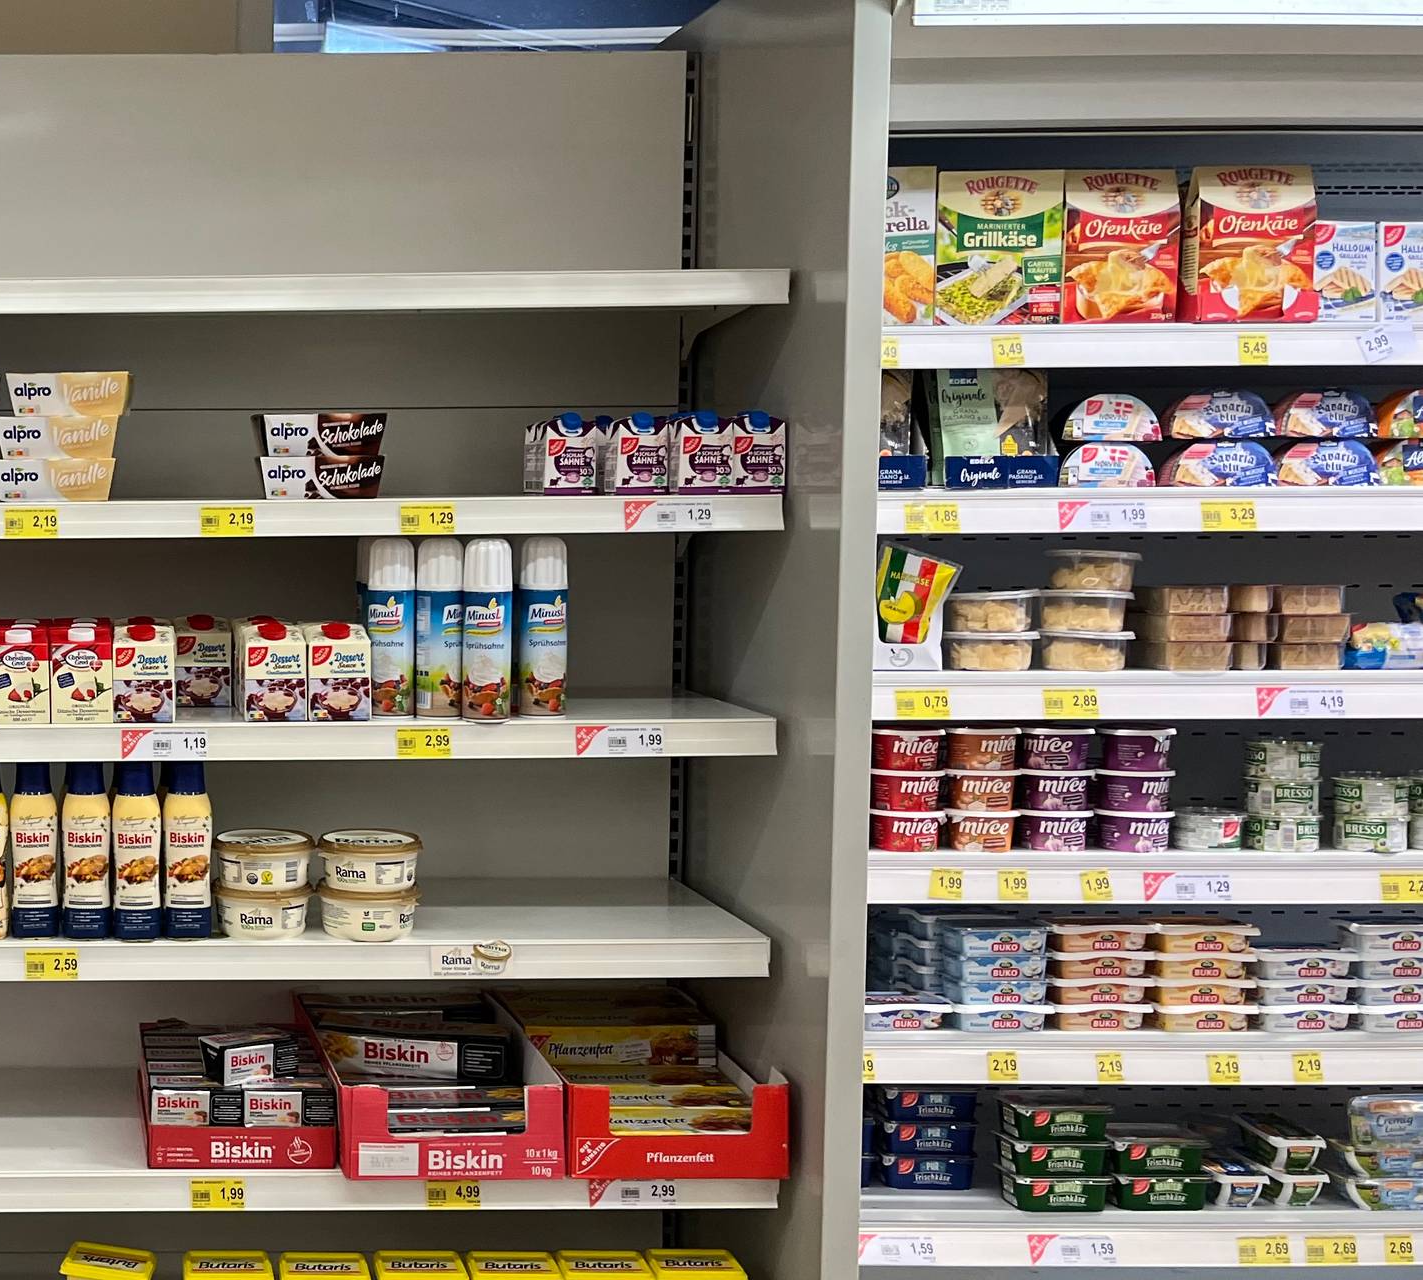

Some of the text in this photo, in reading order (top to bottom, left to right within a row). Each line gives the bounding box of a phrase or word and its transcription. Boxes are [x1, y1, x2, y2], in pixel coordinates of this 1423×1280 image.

[1217, 167, 1296, 187] ROUGETTE
[965, 175, 1041, 195] ROUGETTE
[977, 223, 1026, 231] MARINIERTER
[1086, 218, 1162, 238] Ofenkäse
[1219, 215, 1298, 235] Ofenkäse
[964, 232, 1037, 248] Grillkäse
[1333, 243, 1373, 253] HALLOUMI
[998, 343, 1022, 356] 3,49
[1243, 342, 1267, 356] 5,49
[321, 419, 383, 444] Schokolade
[559, 457, 584, 466] SAHNE
[694, 456, 722, 464] SAHNE
[746, 455, 773, 463] SAHNE
[1311, 452, 1358, 465] Bavaria
[1325, 462, 1342, 472] blu
[49, 466, 107, 489] Vanille
[319, 462, 381, 487] Schokolade
[960, 469, 1001, 487] Originale
[229, 513, 254, 526] 2,19
[429, 512, 454, 526] 1,29
[688, 509, 711, 521] 1,29
[934, 511, 957, 522] 1,89
[1122, 509, 1145, 521] 1,99
[1230, 509, 1255, 521] 3,29
[33, 516, 57, 528] 2,19
[467, 608, 502, 621] MinusL
[530, 605, 565, 619] MinusL
[270, 653, 300, 663] Dessert
[335, 652, 364, 663] Dessert
[924, 696, 948, 708] 0,79
[1073, 694, 1097, 709] 2,89
[1320, 695, 1344, 709] 4,19
[184, 738, 207, 750] 1,19
[425, 734, 449, 749] 2,99
[639, 734, 662, 748] 1,99
[1038, 777, 1086, 794] miree
[1276, 788, 1313, 798] BRESSO
[1039, 818, 1086, 835] miree
[1345, 825, 1385, 834] BRESSO
[16, 832, 50, 843] Biskin
[68, 831, 102, 843] Biskin
[118, 833, 152, 845] Biskin
[170, 832, 205, 843] Biskin
[335, 865, 366, 880] Rama
[939, 876, 962, 890] 1,99
[1004, 878, 1027, 890] 1,99
[1086, 877, 1109, 891] 1,99
[1207, 881, 1229, 894] 1,29
[240, 913, 272, 926] Rama
[1394, 942, 1420, 950] BUKO
[54, 959, 78, 971] 2,59
[442, 955, 472, 966] Rama
[1299, 1021, 1324, 1029] BUKO
[1398, 1020, 1422, 1028] BUKO
[365, 1041, 429, 1065] Biskin
[548, 1041, 614, 1059] Pflanzenfett
[993, 1060, 1017, 1072] 2,19
[1099, 1060, 1122, 1072] 2,19
[1215, 1062, 1239, 1074] 2,19
[1298, 1060, 1321, 1073] 2,19
[211, 1142, 273, 1159] Biskin
[428, 1150, 504, 1170] Biskin
[647, 1152, 715, 1164] Pflanzenfett
[531, 1167, 551, 1177] 10 kg
[220, 1186, 244, 1201] 1,99
[456, 1185, 480, 1199] 4,99
[651, 1185, 675, 1198] 2,99
[1050, 1195, 1086, 1204] Frischkäse
[911, 1243, 934, 1256] 1,59
[1091, 1243, 1114, 1255] 1,59
[1265, 1243, 1289, 1255] 2,69
[1334, 1243, 1356, 1255] 2,69
[1390, 1242, 1413, 1254] 2,69
[391, 1260, 448, 1269] Butaris
[485, 1261, 541, 1270] Butaris
[575, 1261, 632, 1270] Butaris
[665, 1259, 722, 1268] Butaris
